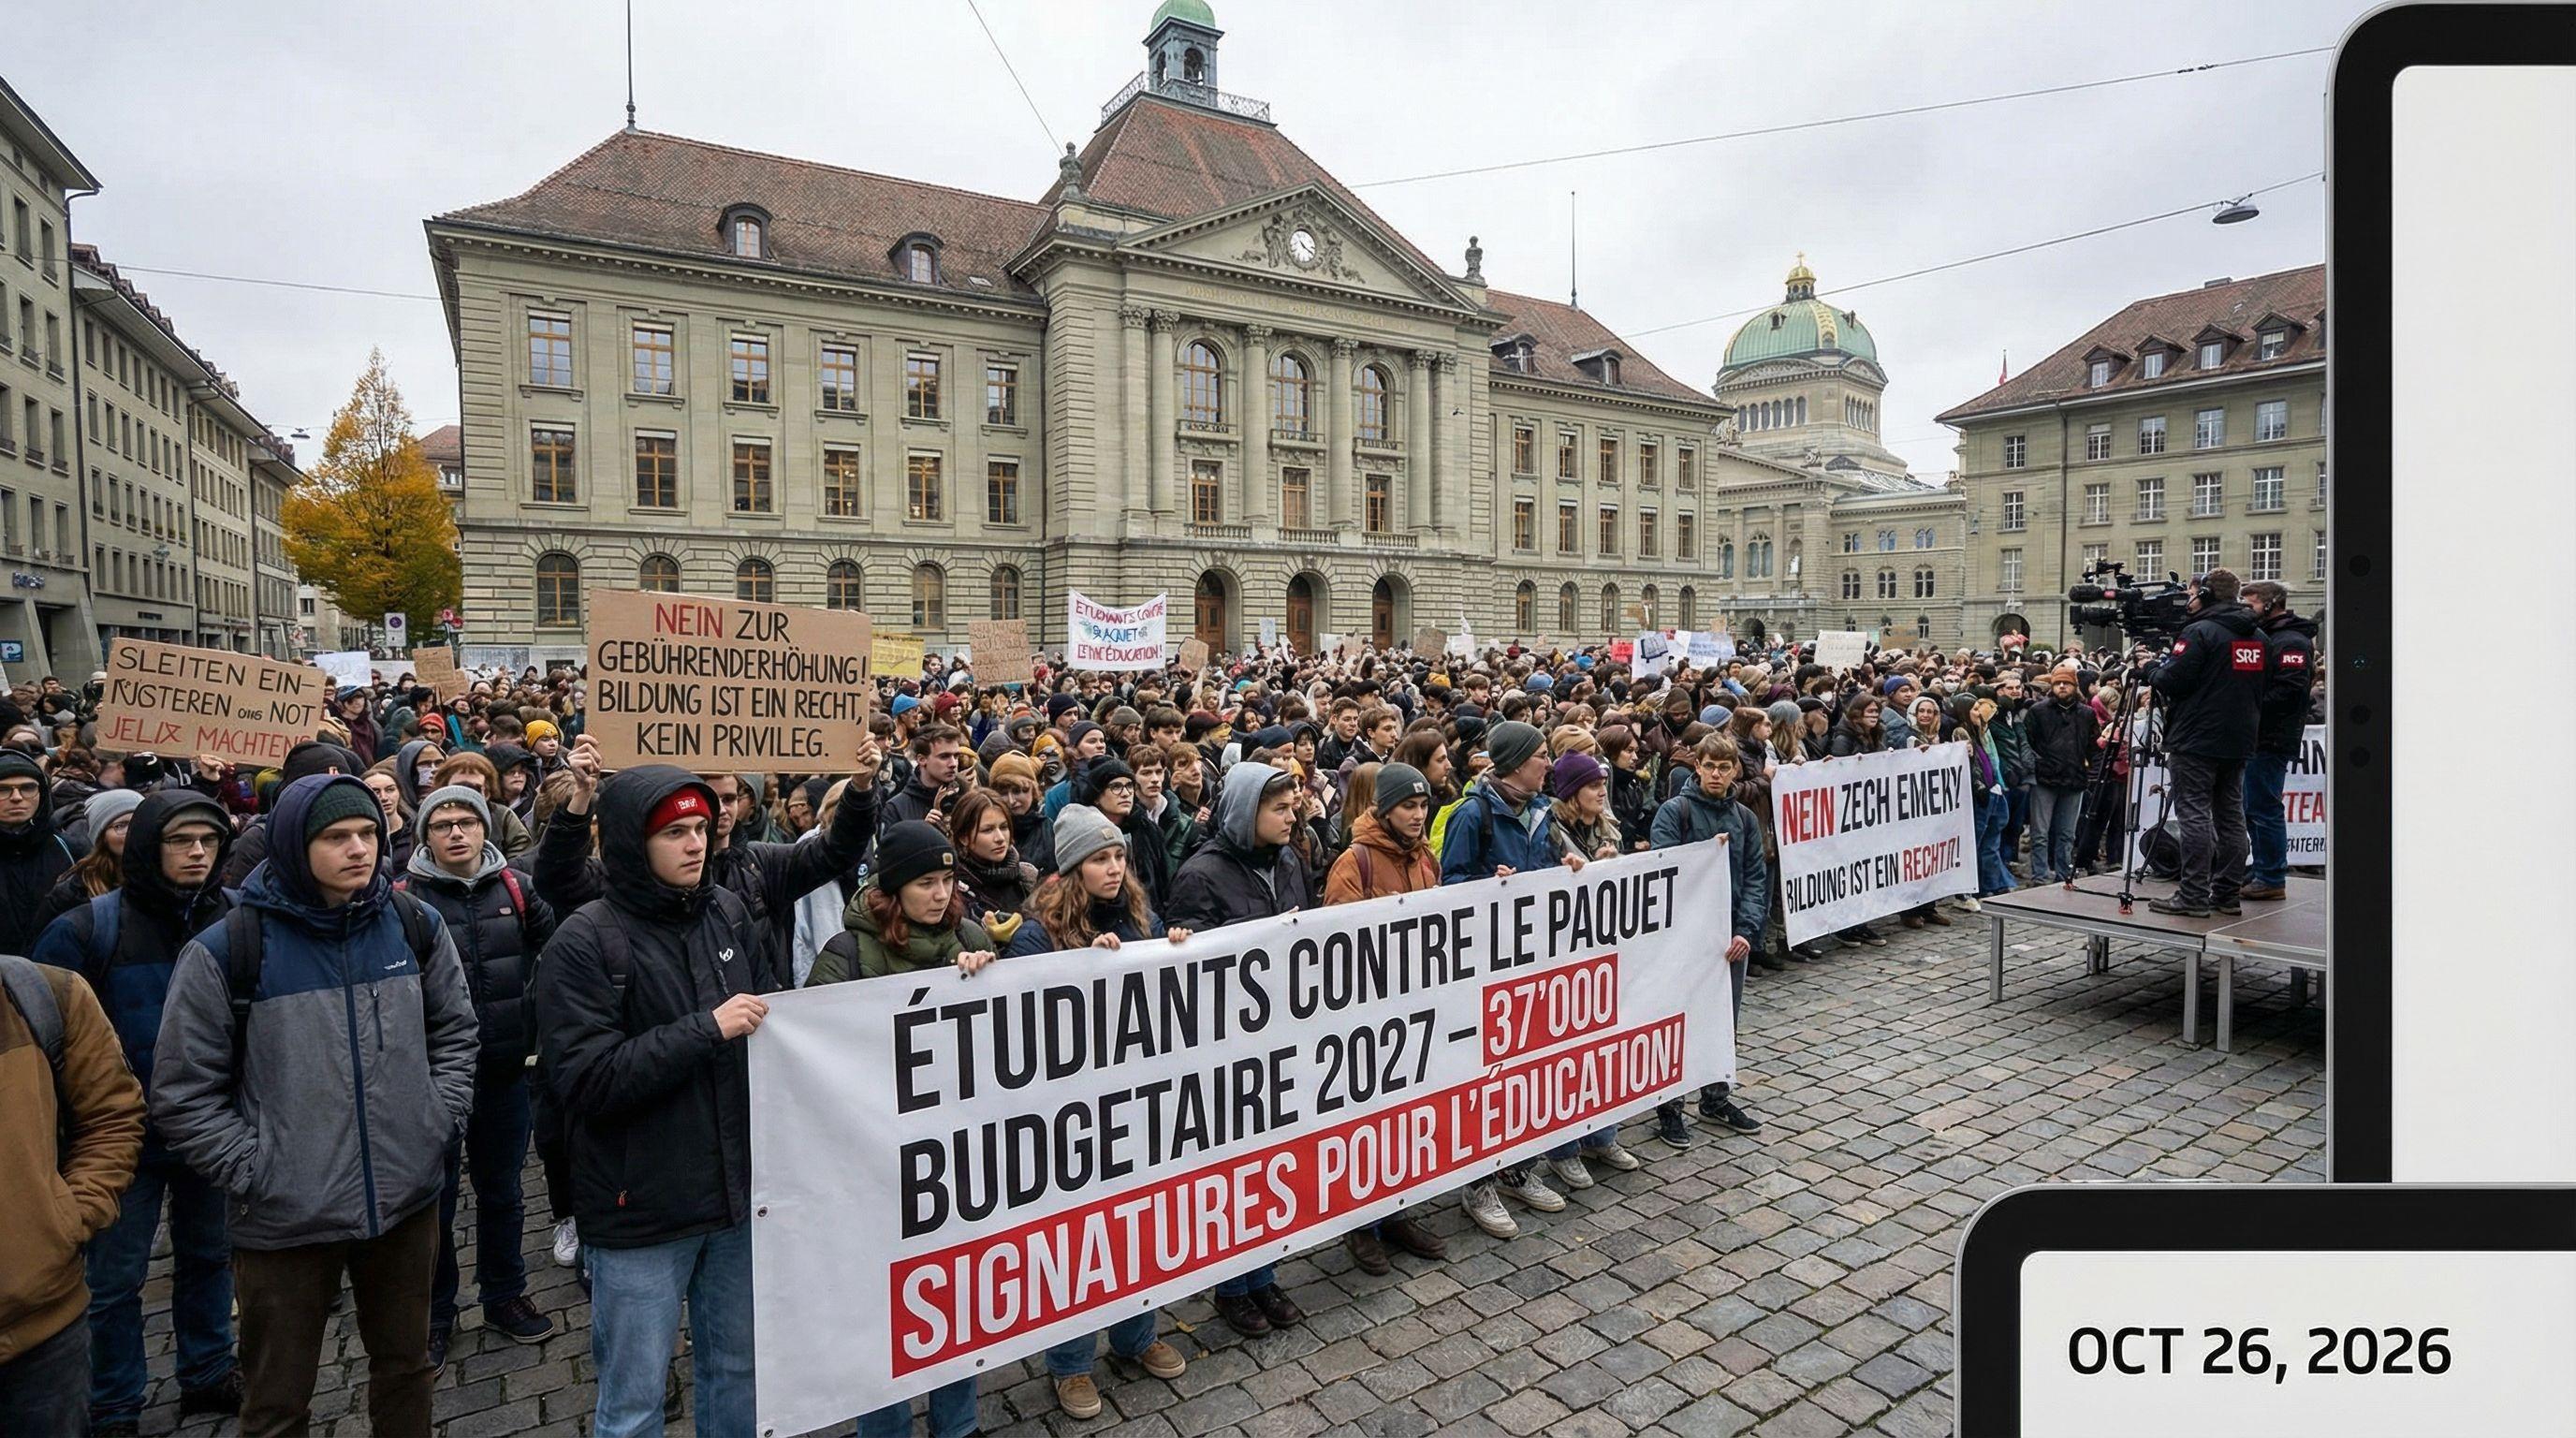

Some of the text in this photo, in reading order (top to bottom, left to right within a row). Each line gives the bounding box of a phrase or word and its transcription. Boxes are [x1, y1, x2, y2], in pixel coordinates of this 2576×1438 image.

[655, 603, 790, 642] NEIN ZUR
[116, 646, 245, 686] SLEITEN
[597, 638, 867, 684] GEBÜHRENDERHÖHUNG!
[2235, 649, 2261, 664] SRF
[270, 701, 316, 726] NOT
[598, 680, 863, 726] BILDUNG IST EIN RECHT,
[196, 726, 311, 759] MACHTEN
[637, 723, 829, 757] KEIN PRIVILEG.
[2290, 740, 2326, 775] AN
[1781, 785, 1835, 846] NEIN
[1840, 777, 1890, 834] ZECH
[2281, 791, 2326, 823] TEA
[1786, 866, 1846, 914] BILDUNG
[1850, 858, 1871, 896] IST
[1875, 852, 1899, 889] EIN
[893, 866, 1679, 1114] ÉTUDIANTS CONTRE LE PAQUET
[900, 1045, 1298, 1240] BUDGETAIRE
[1315, 1008, 1436, 1115] 2027
[901, 1152, 1298, 1360] SIGNATURES
[1317, 1105, 1438, 1214] POUR
[2068, 1327, 2452, 1385] OCT 26, 2026
